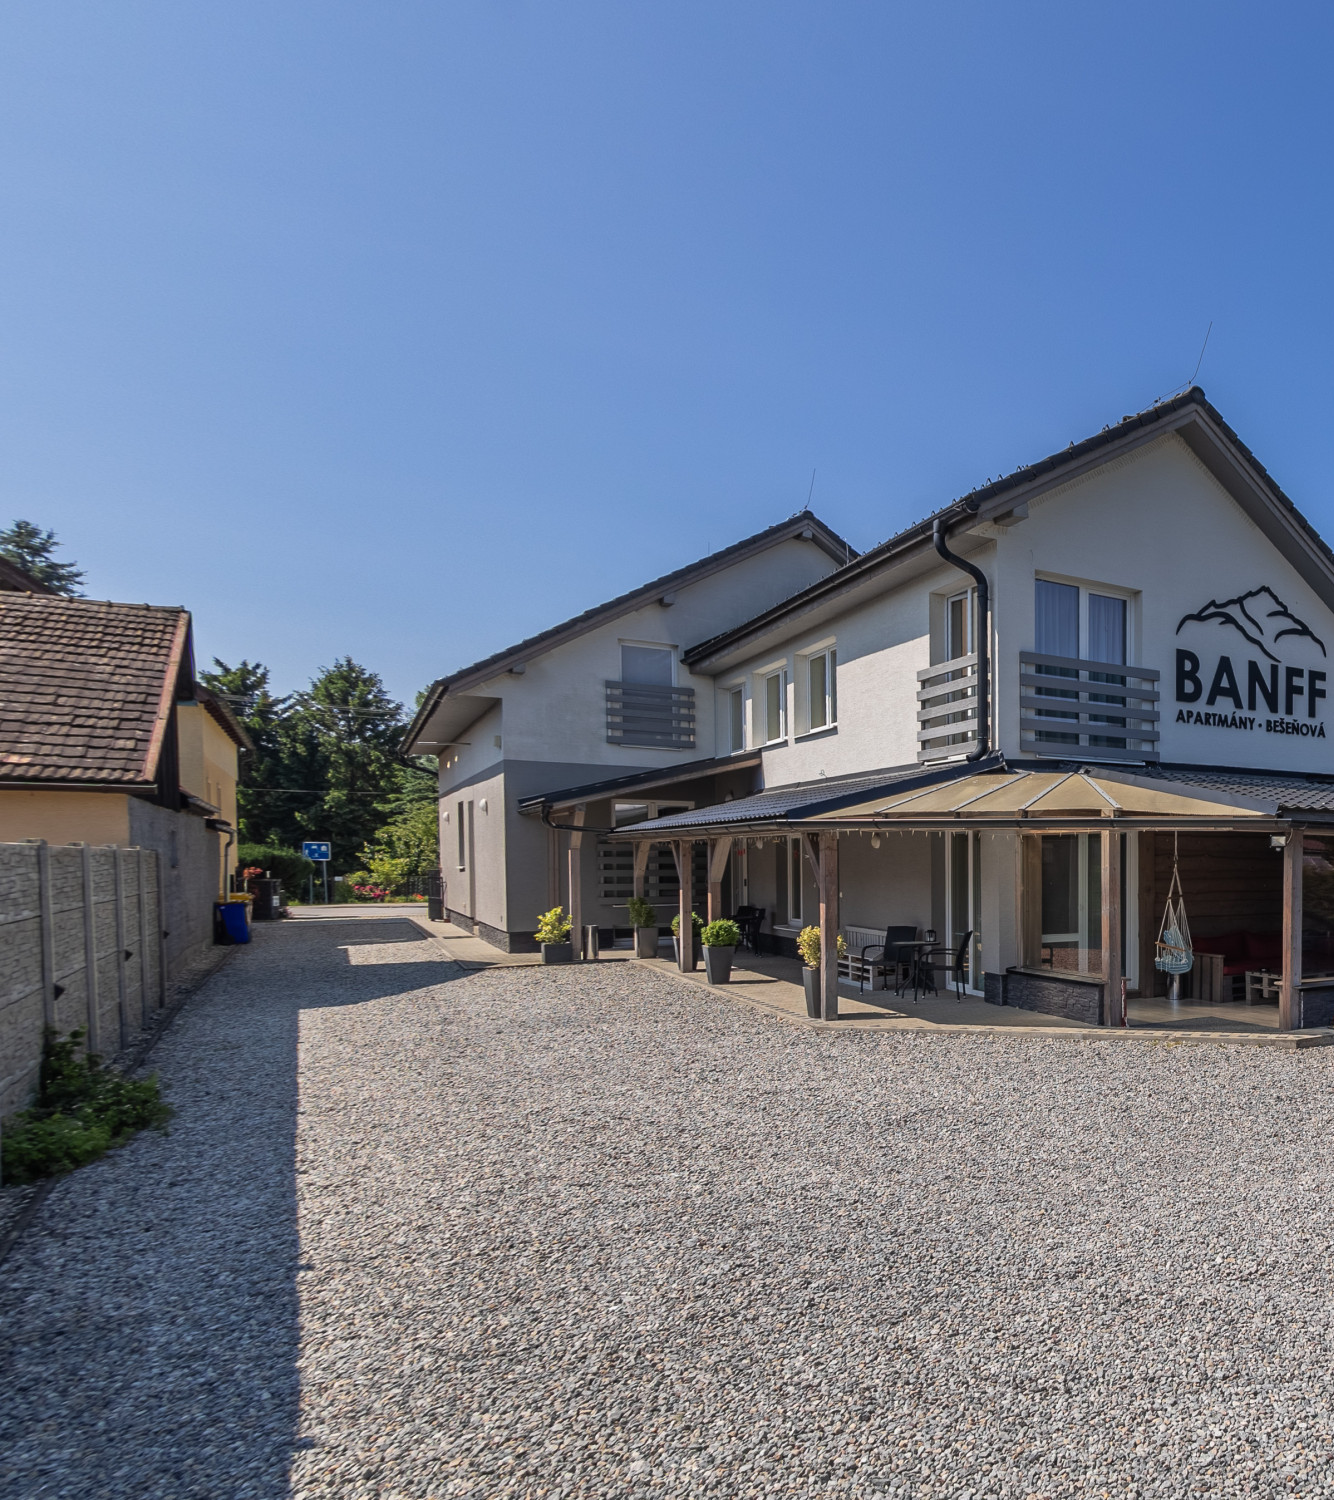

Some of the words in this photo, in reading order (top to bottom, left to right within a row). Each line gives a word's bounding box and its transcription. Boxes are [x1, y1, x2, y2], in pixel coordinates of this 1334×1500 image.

[1176, 648, 1327, 718] BANFF
[1175, 709, 1255, 730] APARTMÁNY
[1266, 717, 1326, 738] BEŠEŇOVÁ
